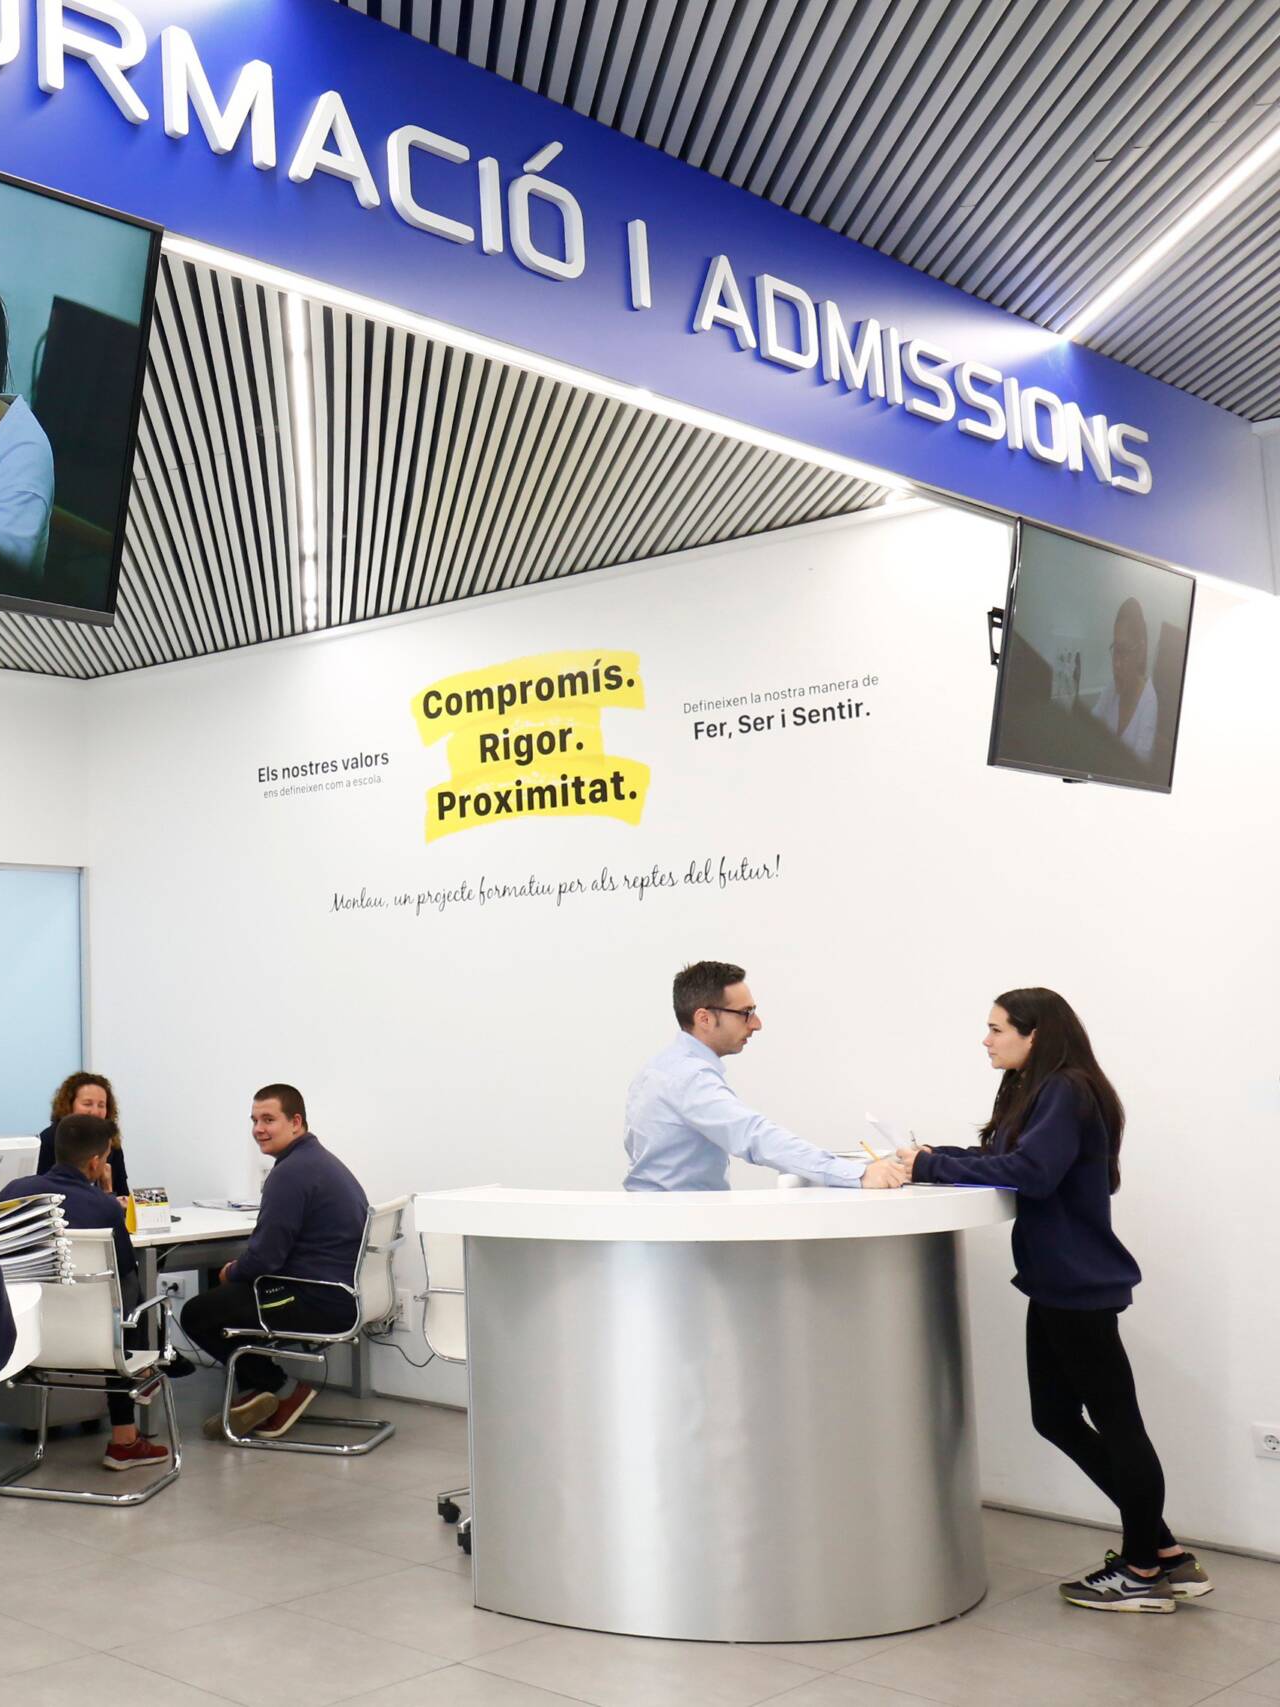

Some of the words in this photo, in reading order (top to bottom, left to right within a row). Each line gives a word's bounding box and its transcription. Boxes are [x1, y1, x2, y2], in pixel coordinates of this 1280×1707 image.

[627, 219, 651, 311] I
[693, 254, 1152, 495] ADMISSIONS
[422, 658, 635, 719] Compromís.
[683, 696, 747, 714] Defineixen
[750, 692, 761, 704] la
[764, 687, 805, 702] nostra
[808, 678, 859, 696] manera
[862, 674, 879, 688] de
[694, 721, 733, 740] Fer,
[738, 714, 775, 734] Ser
[780, 708, 786, 729] i
[792, 698, 871, 727] Sentir.
[258, 766, 278, 783] Els
[281, 760, 338, 780] nostres
[341, 752, 390, 771] valors
[479, 727, 584, 767] Rigor.
[263, 788, 278, 799] ens
[279, 780, 324, 797] defineixen
[325, 779, 344, 791] com
[345, 779, 352, 788] a
[437, 771, 638, 821] Proximitat.
[329, 887, 389, 912] Monlau,
[394, 893, 414, 906] un
[416, 880, 475, 917] projecte
[478, 875, 554, 906] formatiu
[556, 878, 586, 907] per
[591, 866, 619, 892] als
[623, 864, 678, 902] reptes
[683, 858, 714, 884] del
[718, 853, 781, 889] futur!
